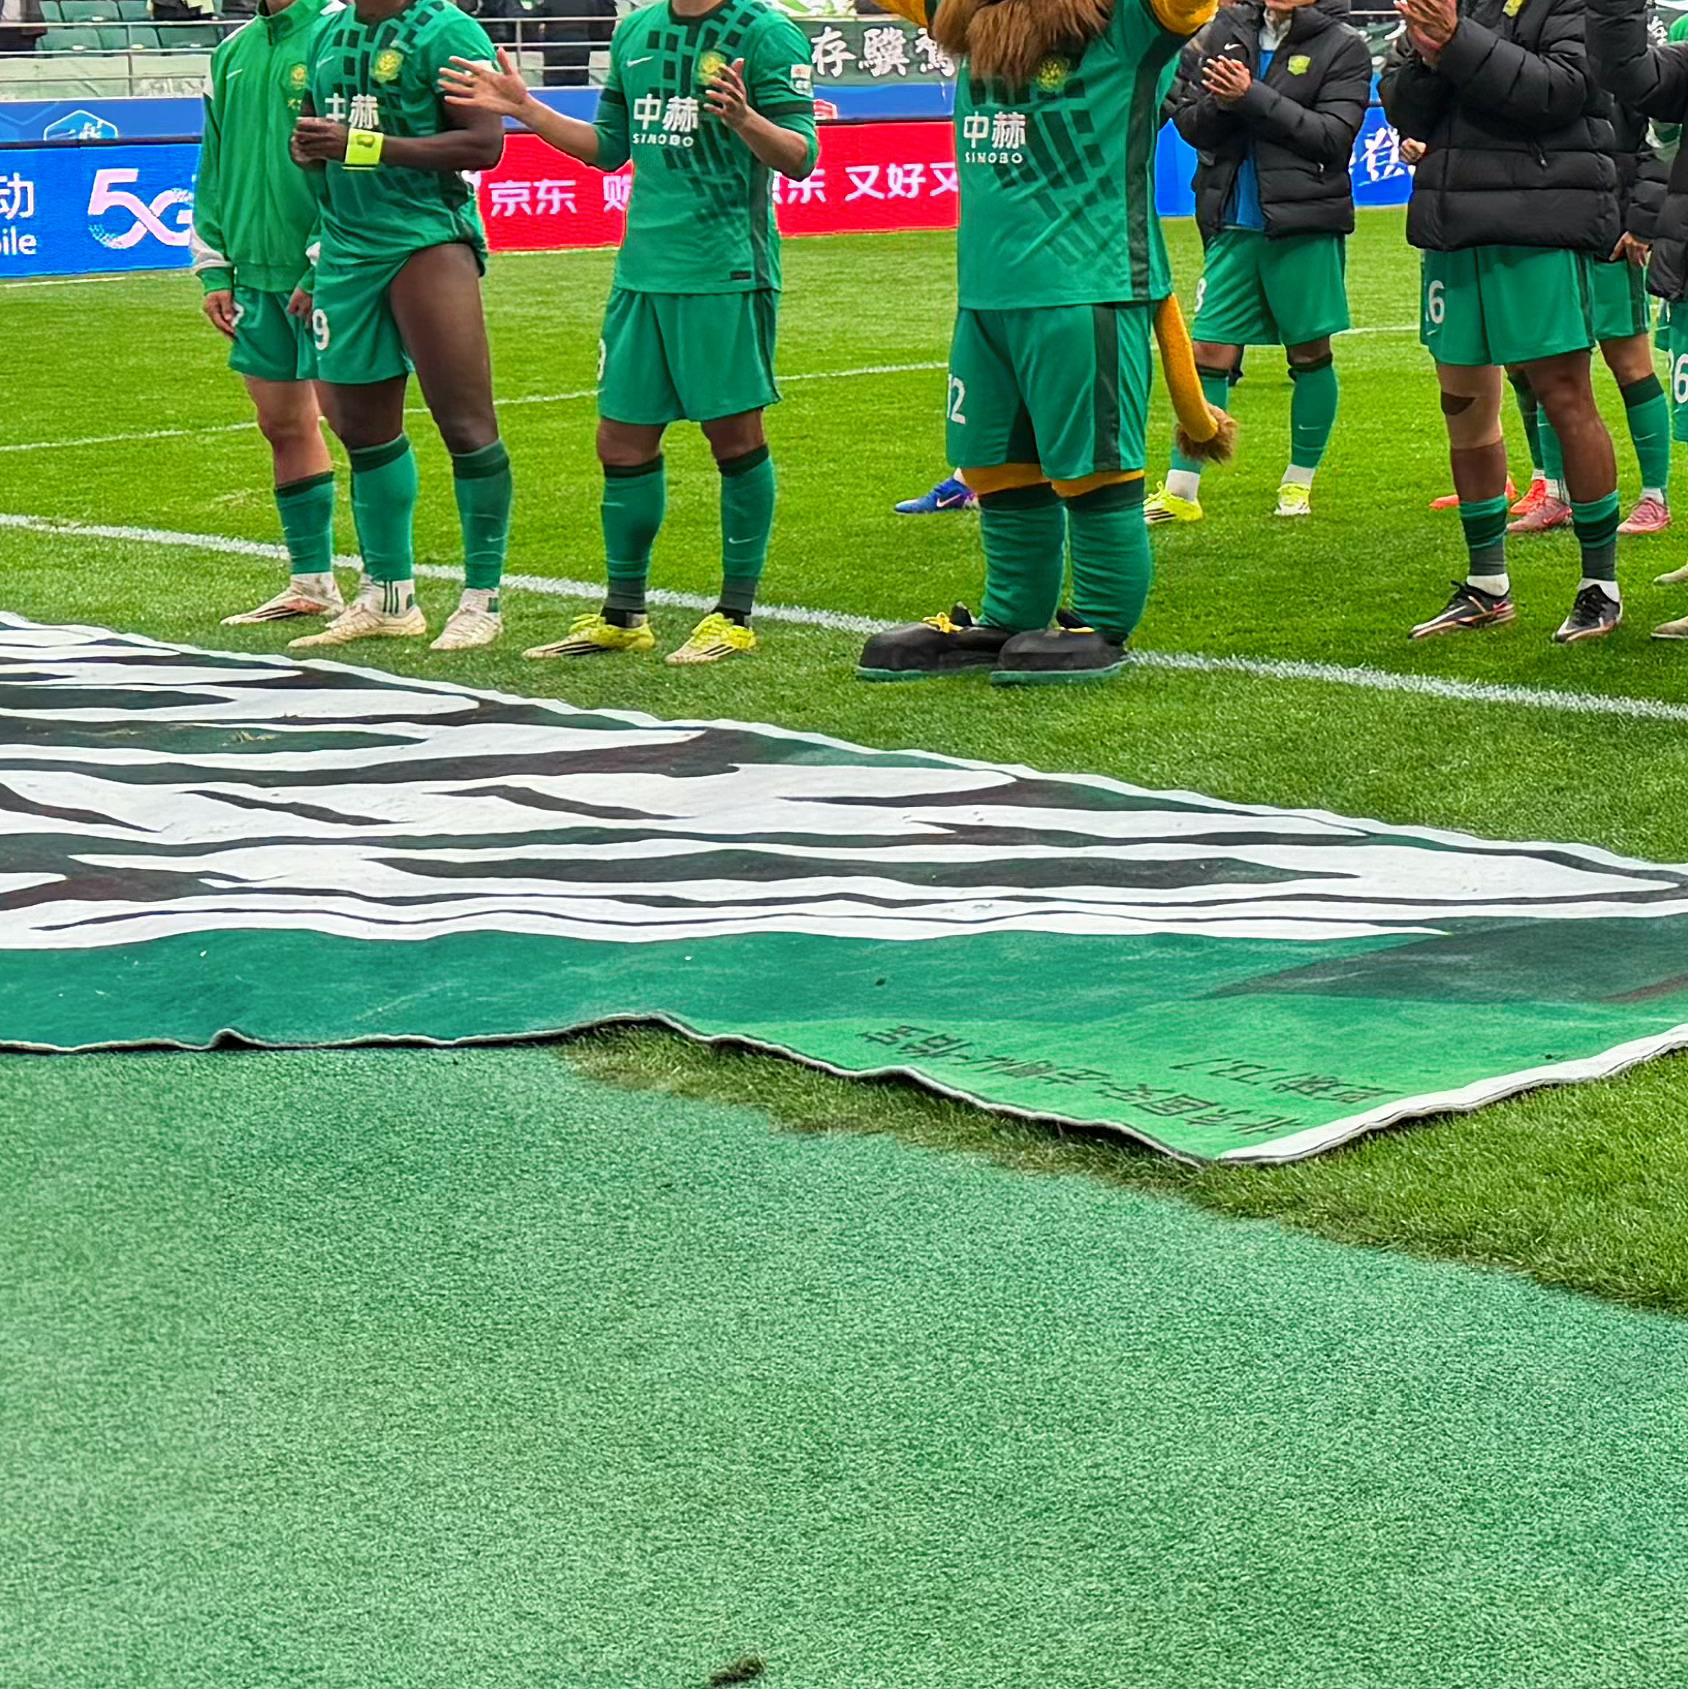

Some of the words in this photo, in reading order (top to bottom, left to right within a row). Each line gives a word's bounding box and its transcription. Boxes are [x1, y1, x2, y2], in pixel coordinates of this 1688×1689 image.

[633, 94, 699, 132] 中赫
[963, 111, 1027, 149] 中赫
[632, 133, 694, 149] SINOBO
[964, 151, 1024, 165] SINOBO
[88, 168, 194, 250] 5G
[490, 179, 577, 217] 京东
[0, 225, 38, 256] ile
[312, 307, 331, 351] 9
